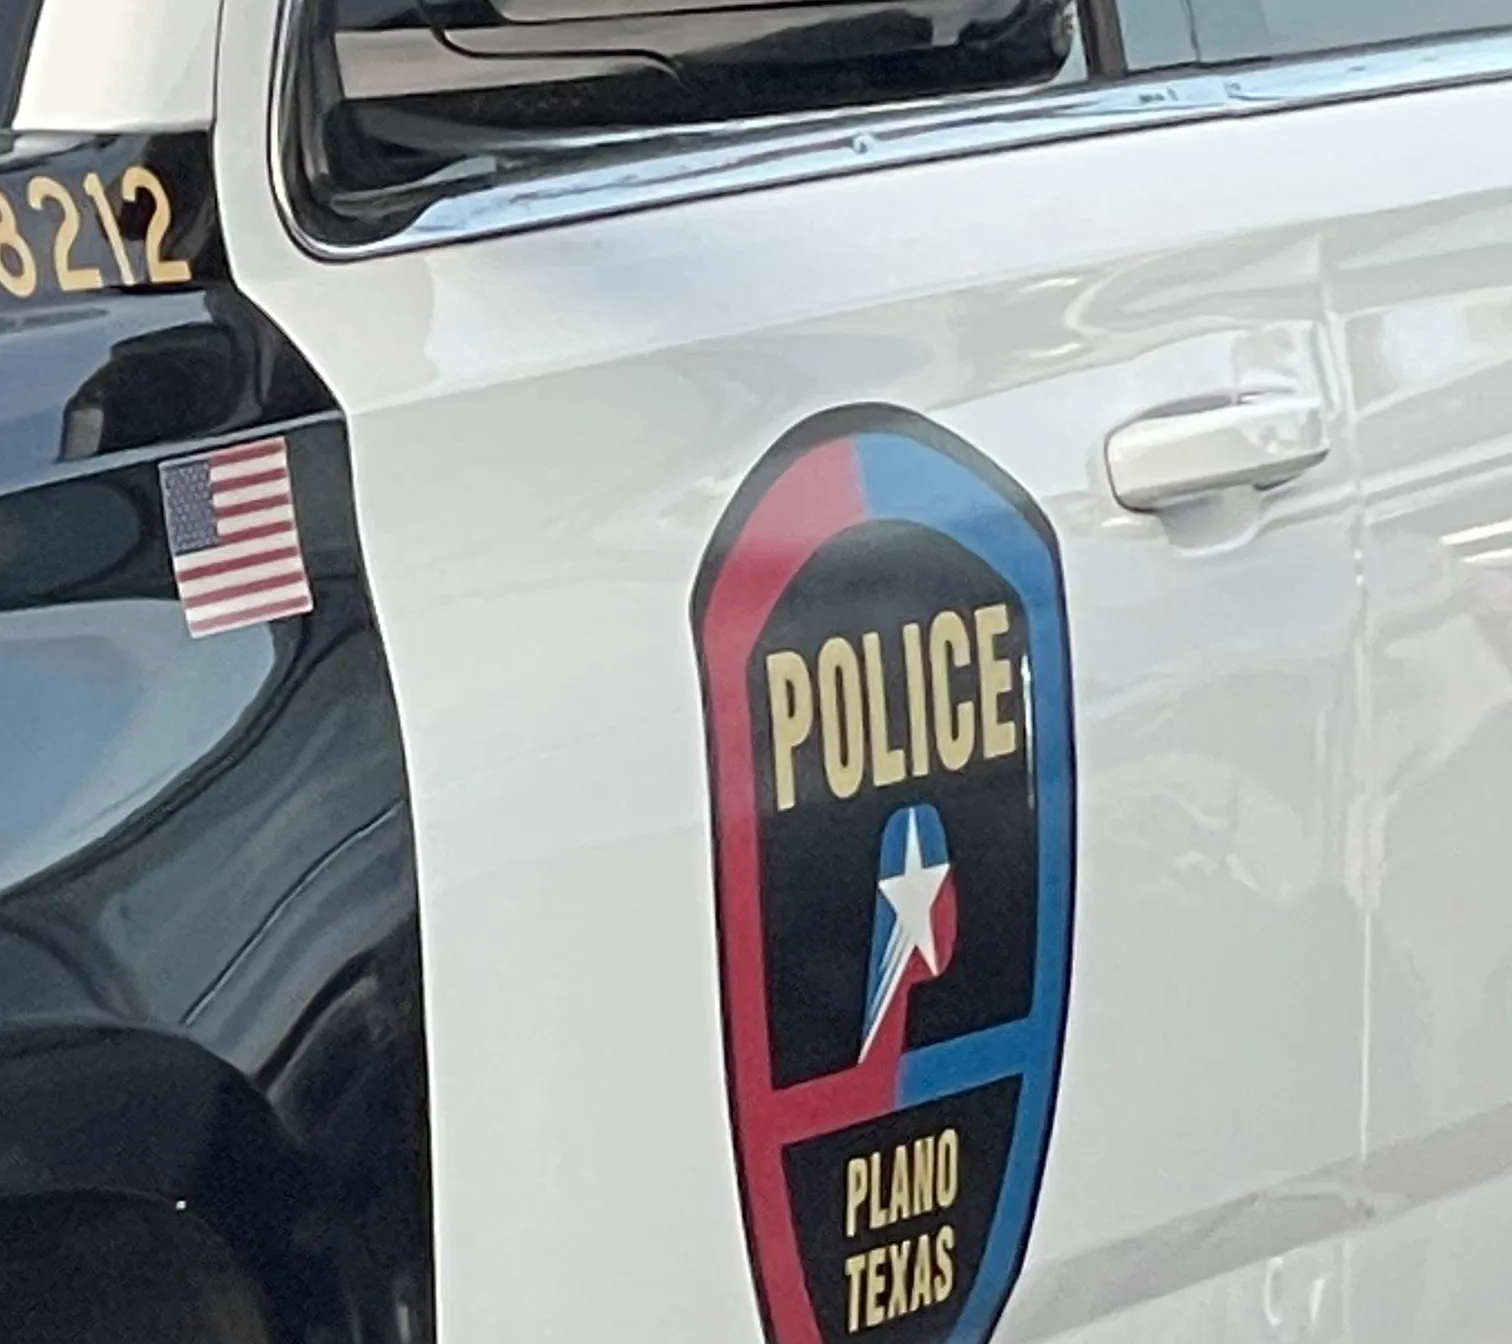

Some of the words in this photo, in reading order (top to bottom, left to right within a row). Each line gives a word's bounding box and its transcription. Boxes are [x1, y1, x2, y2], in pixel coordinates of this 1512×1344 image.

[765, 603, 1016, 812] POLICE
[845, 1127, 959, 1238] PLANO
[844, 1224, 956, 1334] TEXAS
